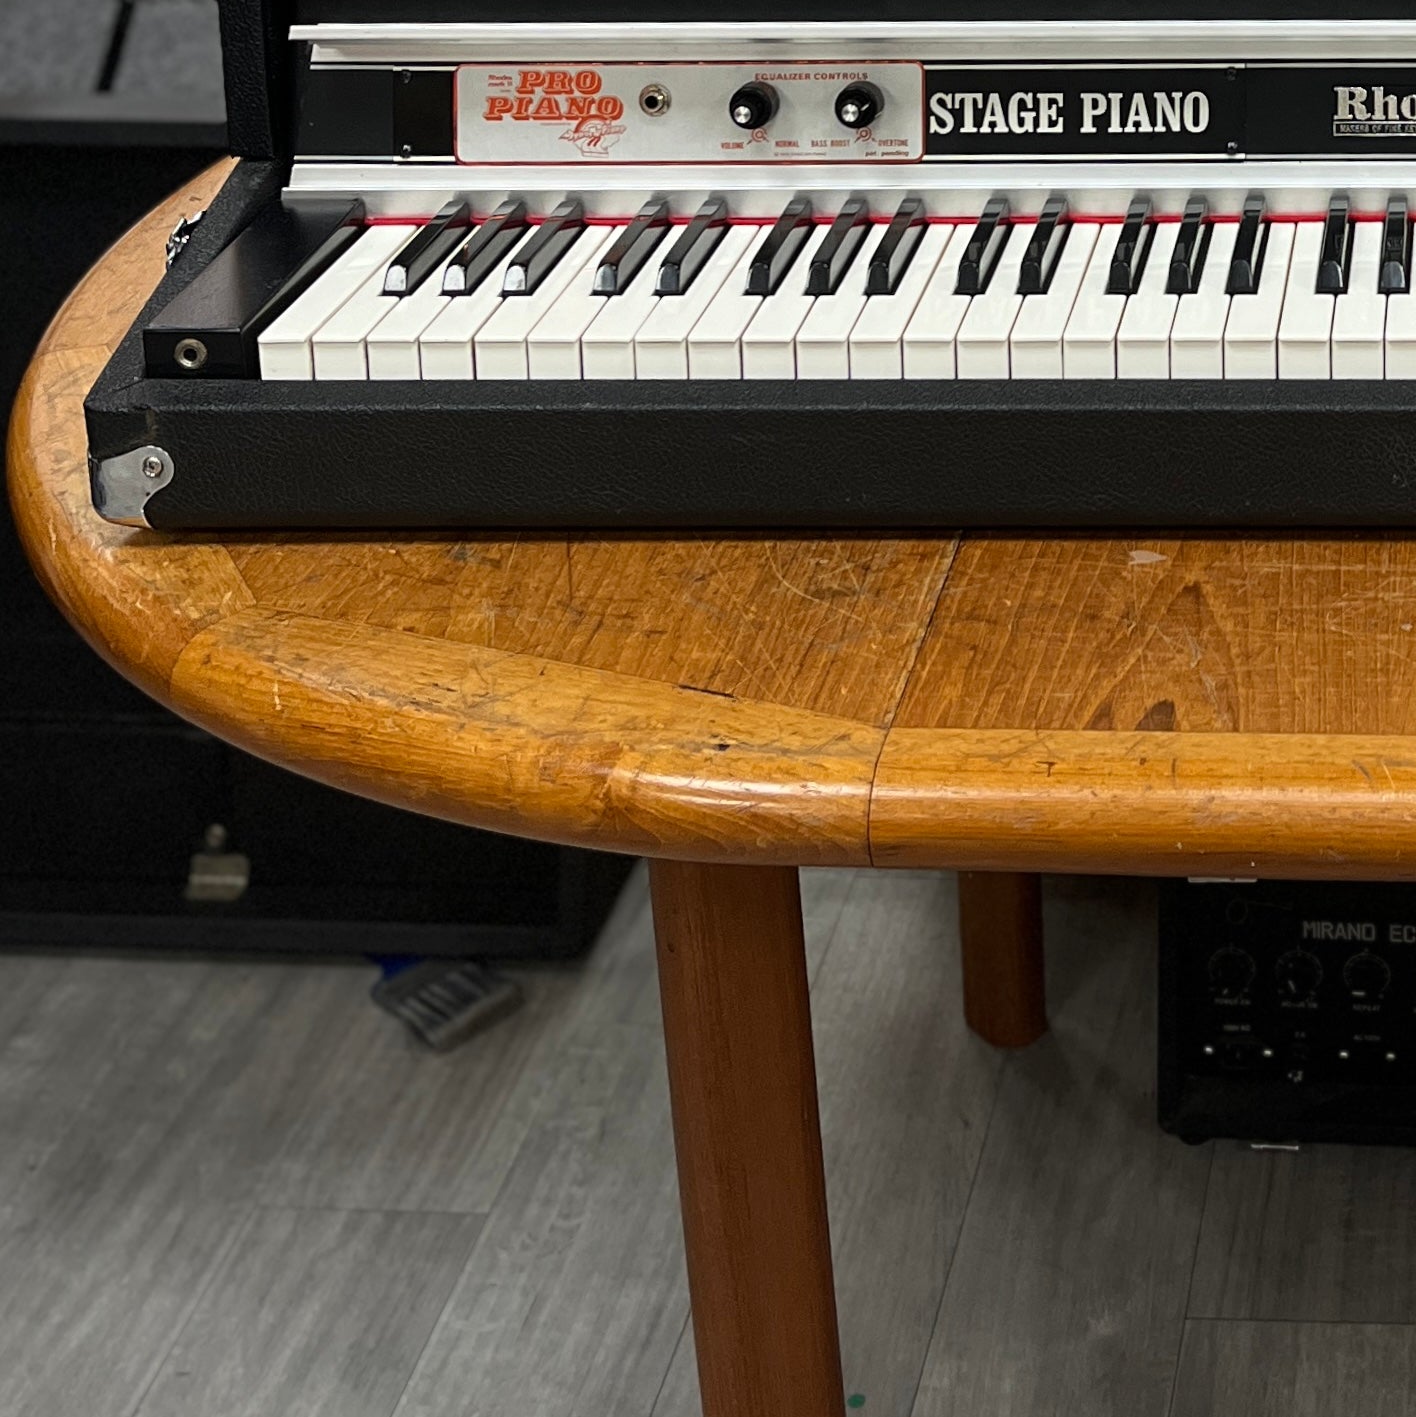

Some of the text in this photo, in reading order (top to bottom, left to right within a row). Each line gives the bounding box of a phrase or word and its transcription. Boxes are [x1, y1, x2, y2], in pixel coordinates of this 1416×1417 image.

[517, 70, 602, 95] PRO
[755, 72, 869, 81] EQUALIZER CONTROLS
[484, 96, 625, 121] PIANO
[929, 91, 1210, 134] STAGE PIANO
[811, 139, 828, 147] BASS
[1302, 919, 1377, 942] MIRANO
